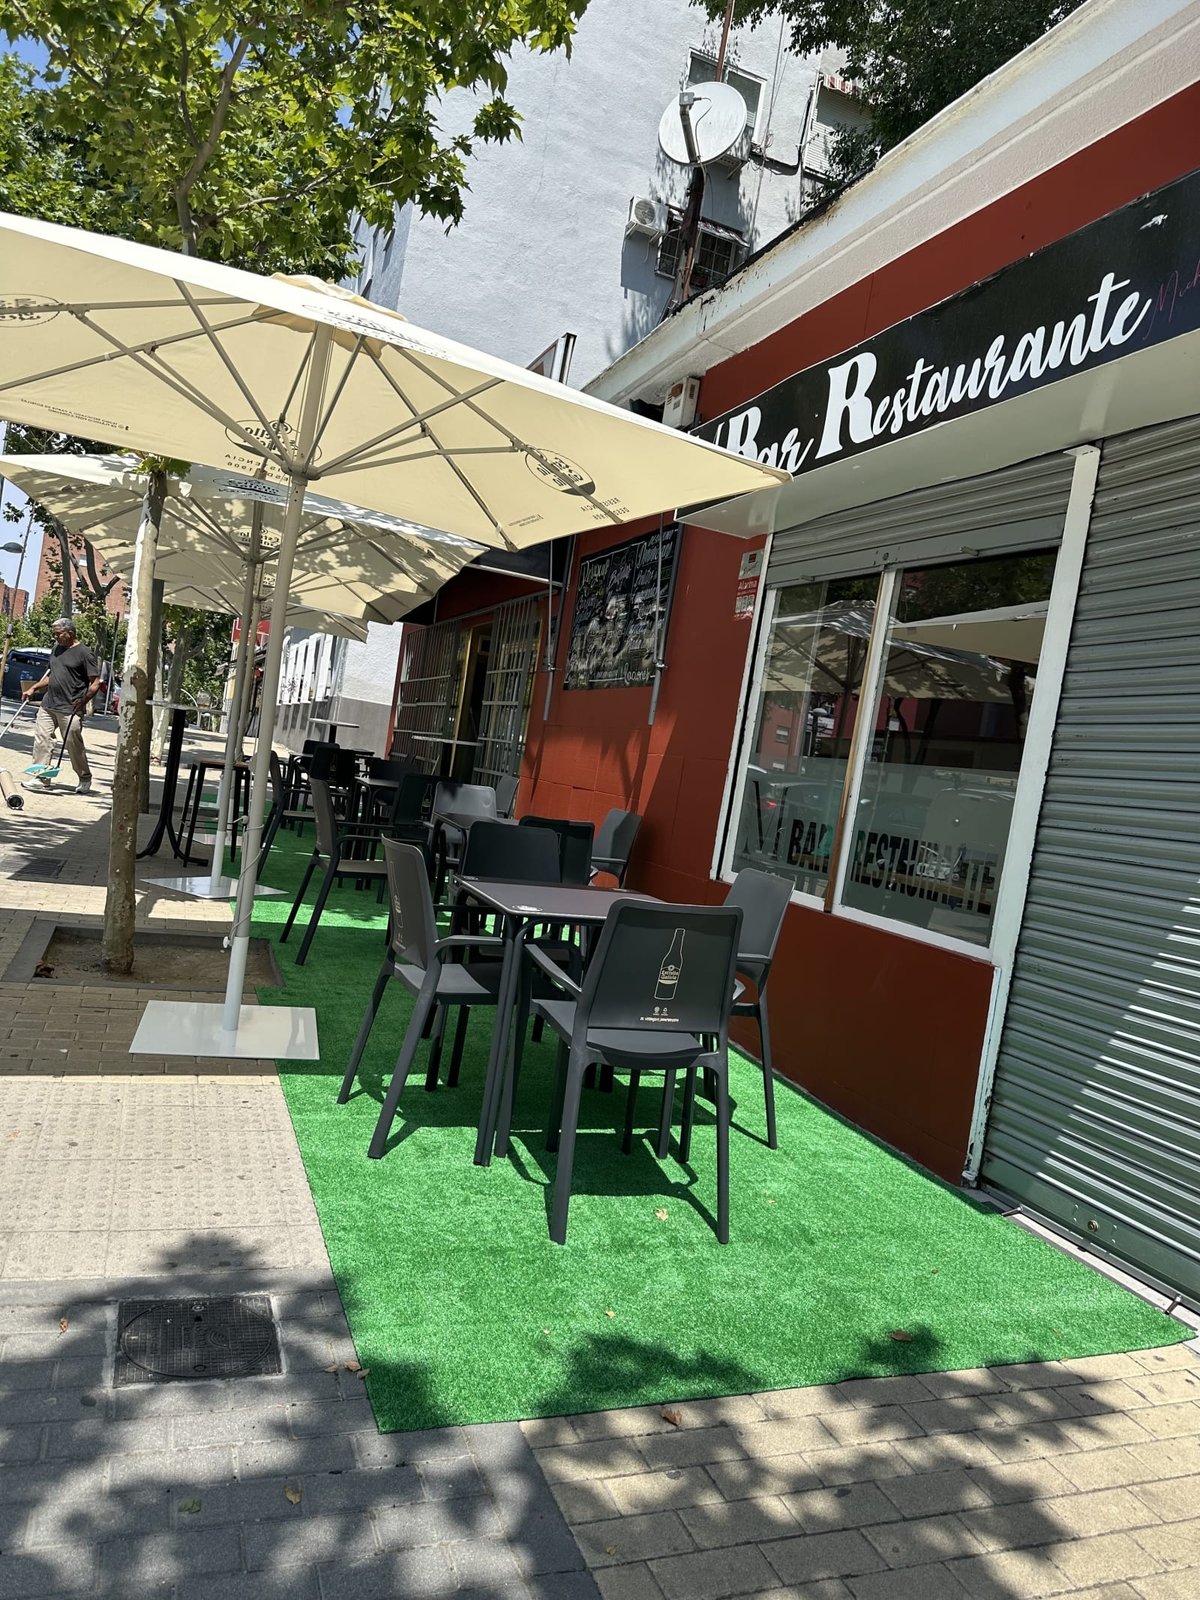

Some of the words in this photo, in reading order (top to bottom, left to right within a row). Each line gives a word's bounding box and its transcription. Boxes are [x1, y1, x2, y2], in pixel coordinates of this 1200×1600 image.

[727, 406, 814, 473] Bar
[815, 272, 1153, 459] Restaurante
[787, 819, 834, 874] BAR
